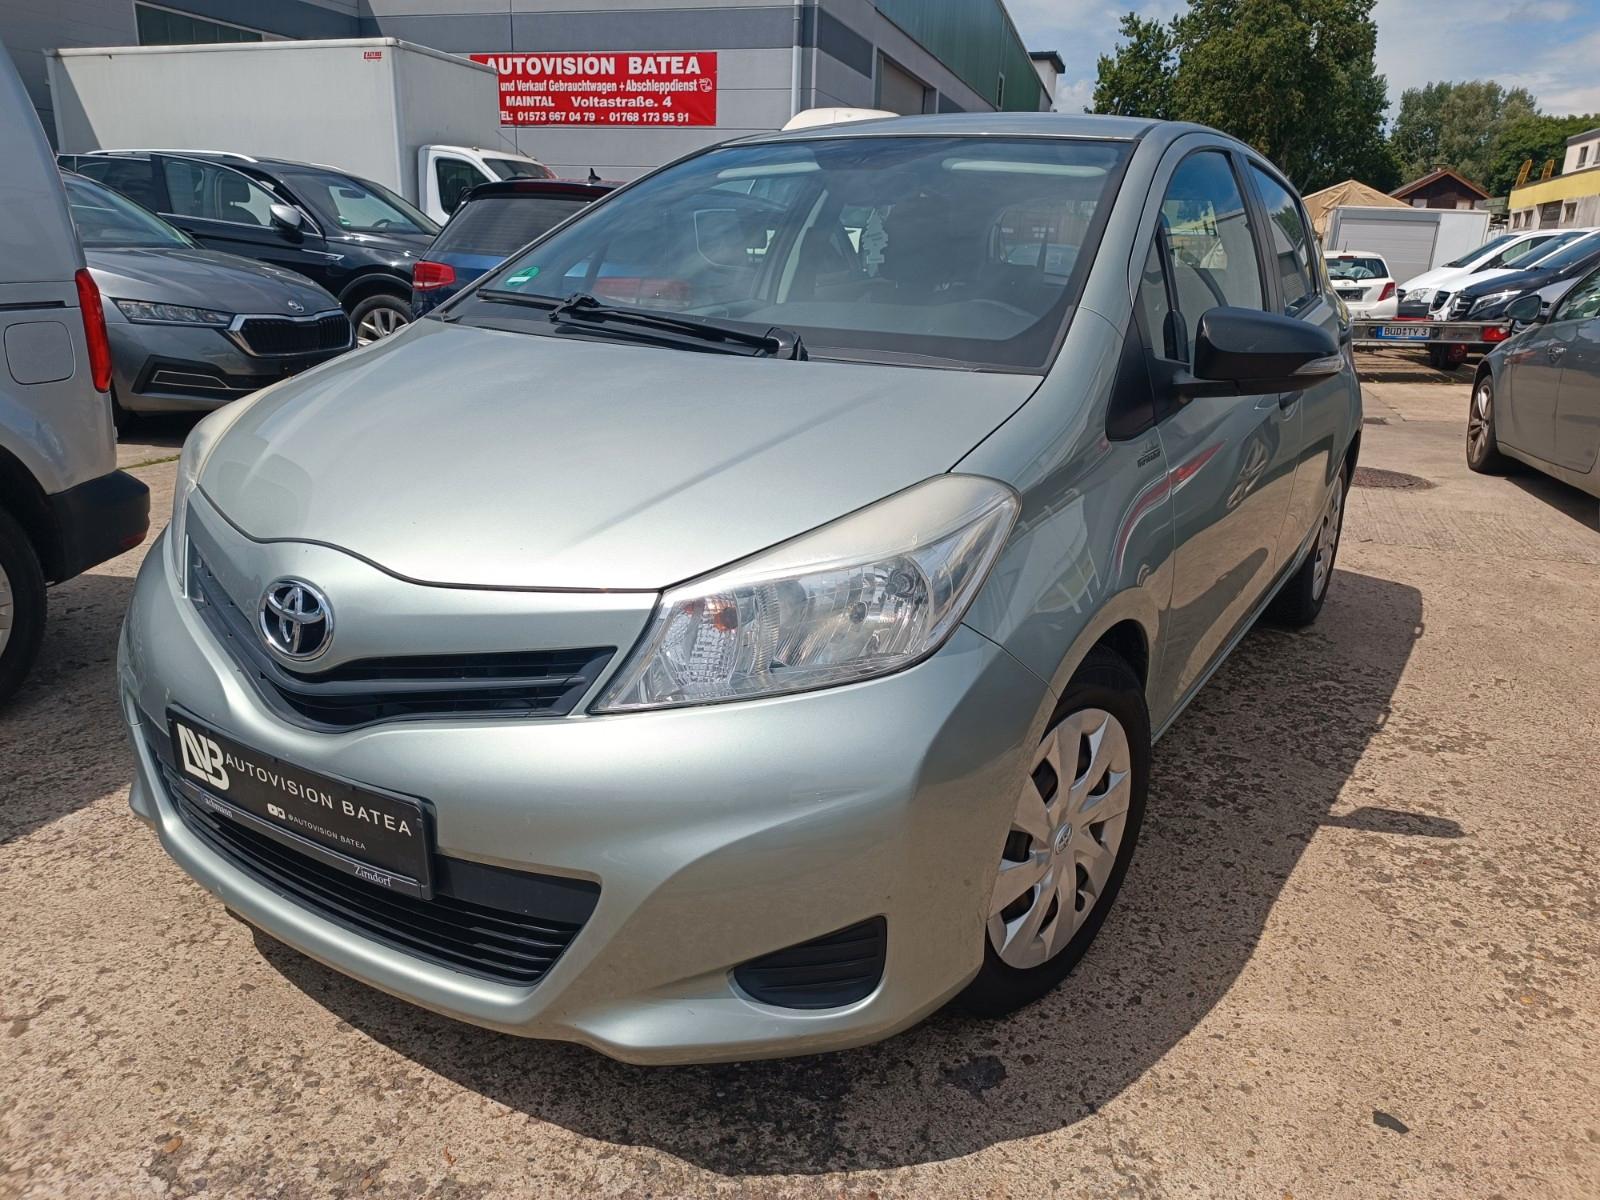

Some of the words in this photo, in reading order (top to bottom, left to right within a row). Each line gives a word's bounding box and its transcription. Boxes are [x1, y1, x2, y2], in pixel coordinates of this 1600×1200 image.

[486, 57, 615, 75] AUTOVISION
[628, 56, 701, 75] BATEA
[500, 80, 515, 91] und
[517, 80, 547, 91] Verkauf
[548, 79, 617, 94] Gebrauchtwagen
[626, 79, 698, 94] Abschleppdienst
[506, 96, 555, 107] MAINTAL
[571, 96, 659, 107] Voltastraße.
[662, 96, 672, 107] 4
[500, 111, 514, 121] EL:
[517, 112, 547, 121] 01573
[548, 112, 566, 121] 667
[568, 112, 581, 121] 04
[583, 112, 596, 121] 79
[609, 112, 639, 122] 01768
[642, 113, 660, 122] 173
[662, 113, 675, 122] 95
[677, 113, 689, 122] 91
[1408, 327, 1419, 336] TY
[1421, 327, 1428, 336] 3
[225, 752, 333, 809] AUTOVISION
[341, 800, 413, 837] BATEA
[339, 834, 367, 851] BATEA
[353, 864, 392, 888] Zirndorf
